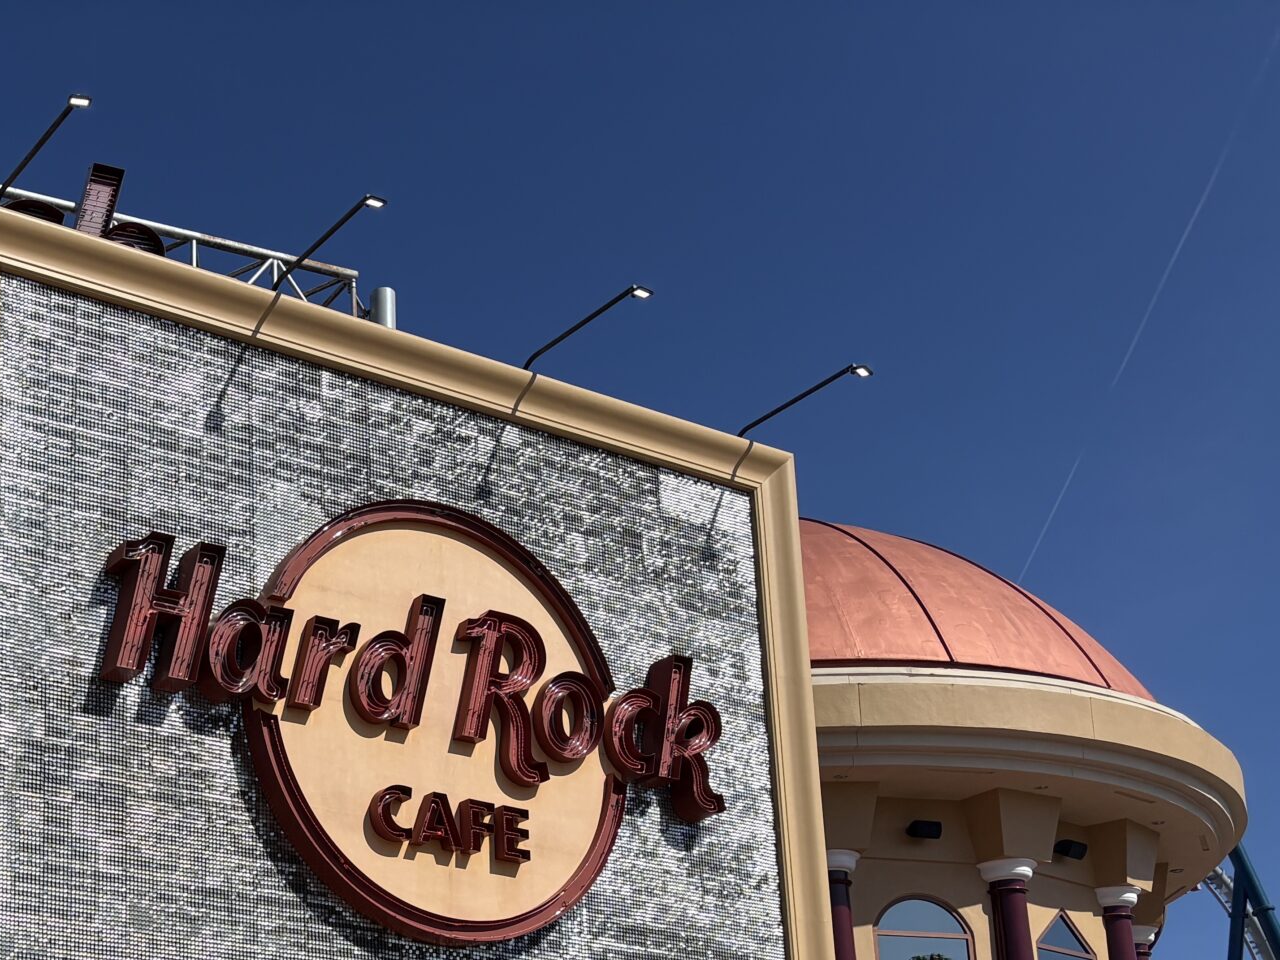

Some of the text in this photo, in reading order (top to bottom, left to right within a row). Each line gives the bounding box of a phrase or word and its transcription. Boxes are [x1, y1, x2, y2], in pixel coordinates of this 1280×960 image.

[99, 531, 726, 823] Hard Rock
[368, 784, 531, 864] CAFE
